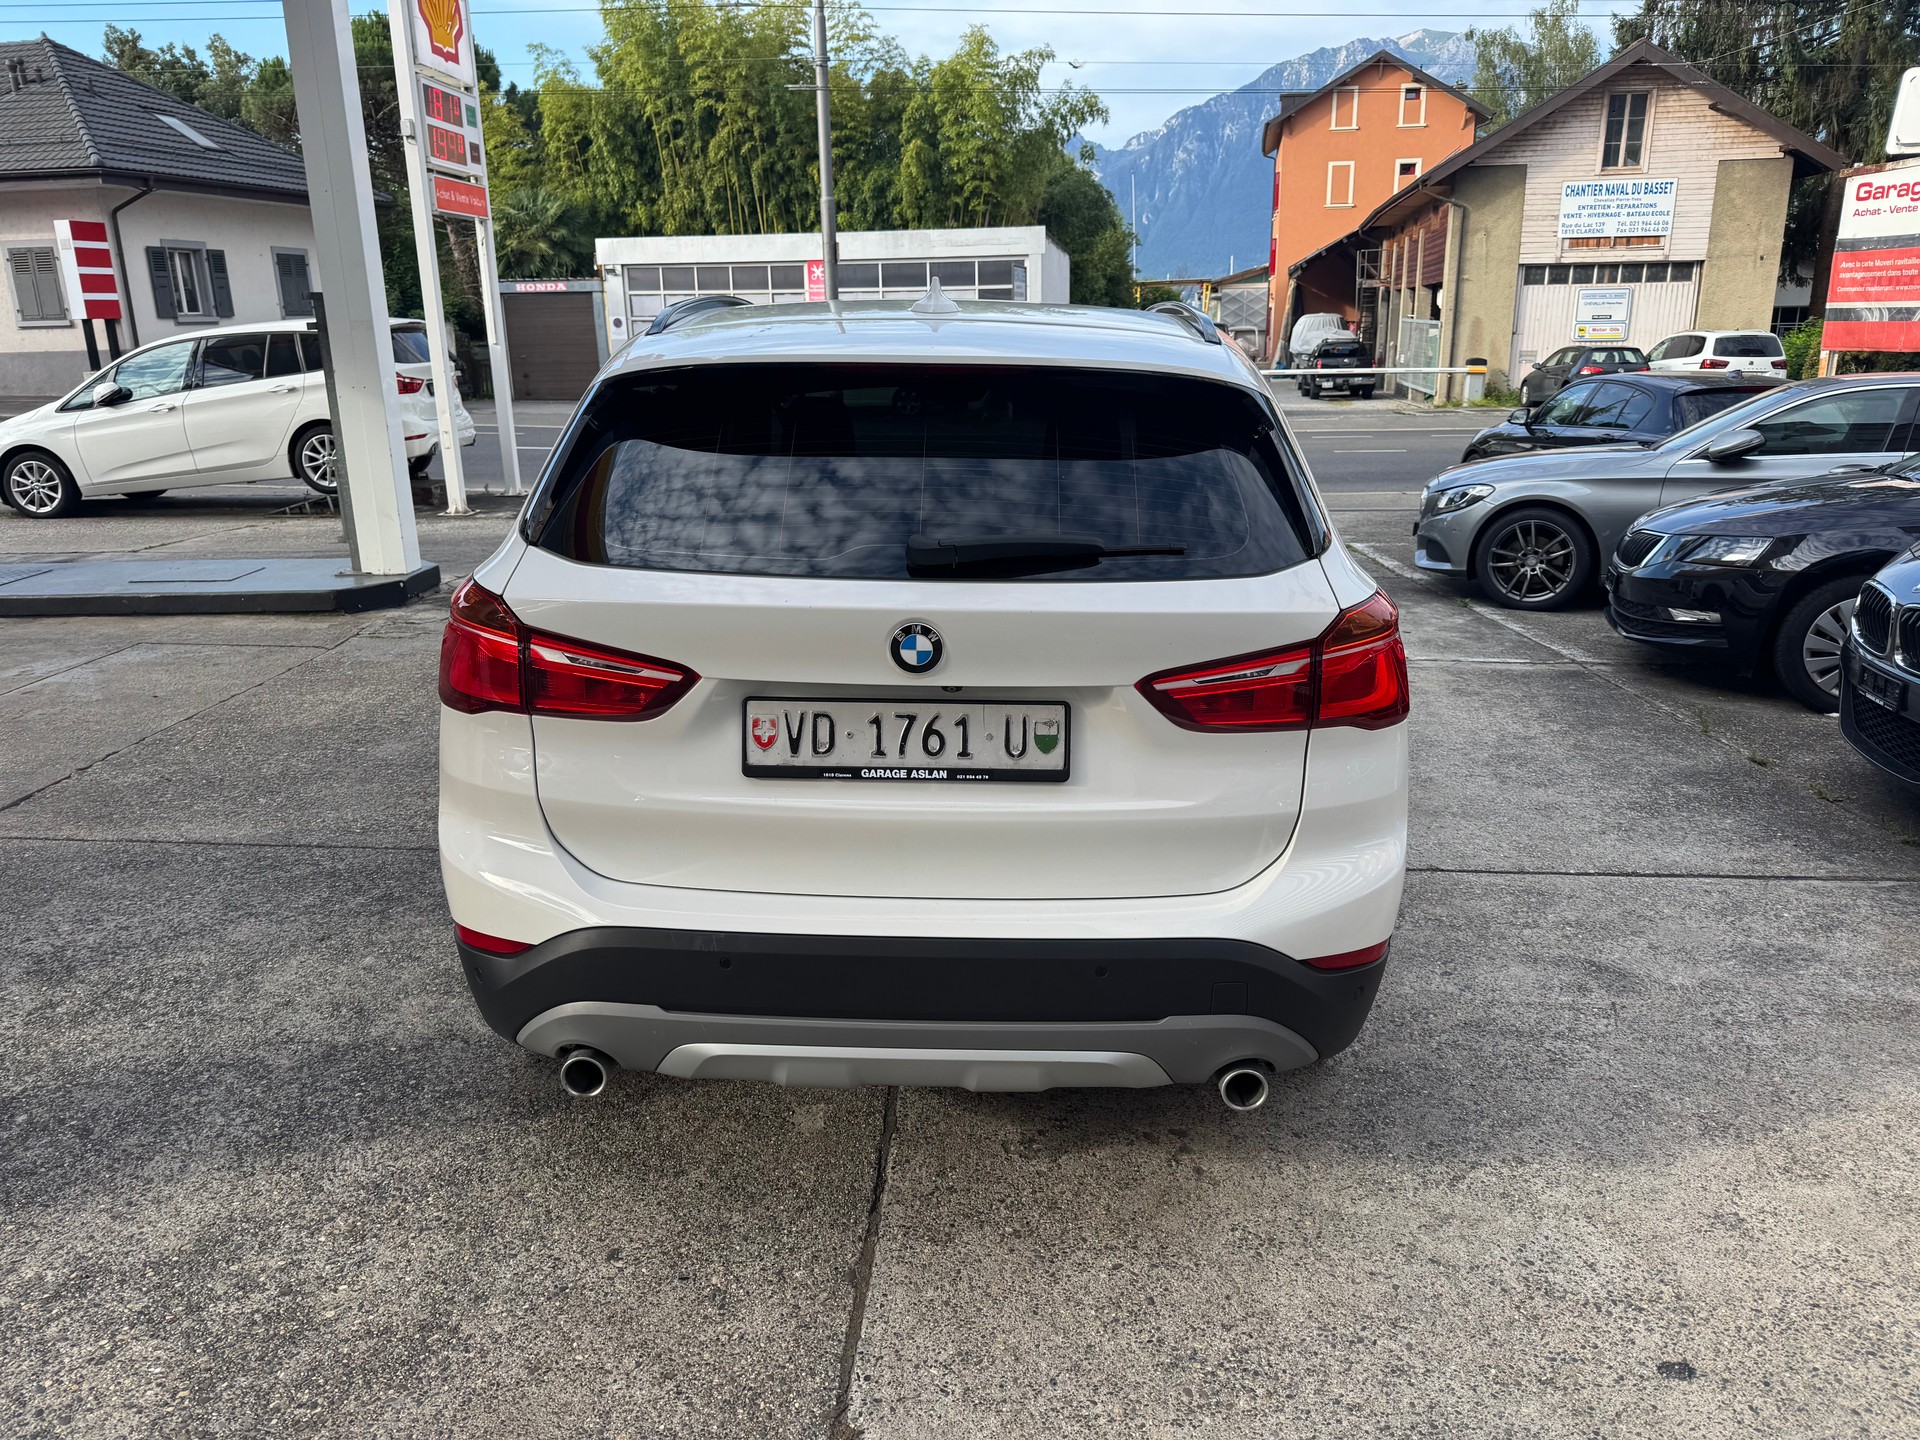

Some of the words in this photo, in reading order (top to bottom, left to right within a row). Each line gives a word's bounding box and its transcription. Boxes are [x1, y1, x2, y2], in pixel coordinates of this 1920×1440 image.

[1565, 184, 1603, 197] CHANTIER
[1604, 183, 1629, 196] NAVAL
[1631, 182, 1642, 195] DU
[1644, 181, 1674, 195] BASSET
[1852, 208, 1882, 217] Achat
[1889, 205, 1918, 214] Vente
[1840, 260, 1855, 268] Avec
[1861, 259, 1874, 267] carte
[1874, 258, 1894, 266] Moveri
[1839, 269, 1886, 279] avantageusement
[1902, 268, 1918, 276] toute
[516, 282, 567, 291] HONDA
[894, 624, 939, 642] BMW
[782, 710, 836, 758] VD
[866, 711, 973, 760] 1761
[1003, 713, 1030, 760] U
[861, 768, 907, 778] GARAGE
[910, 769, 947, 779] ASLAN
